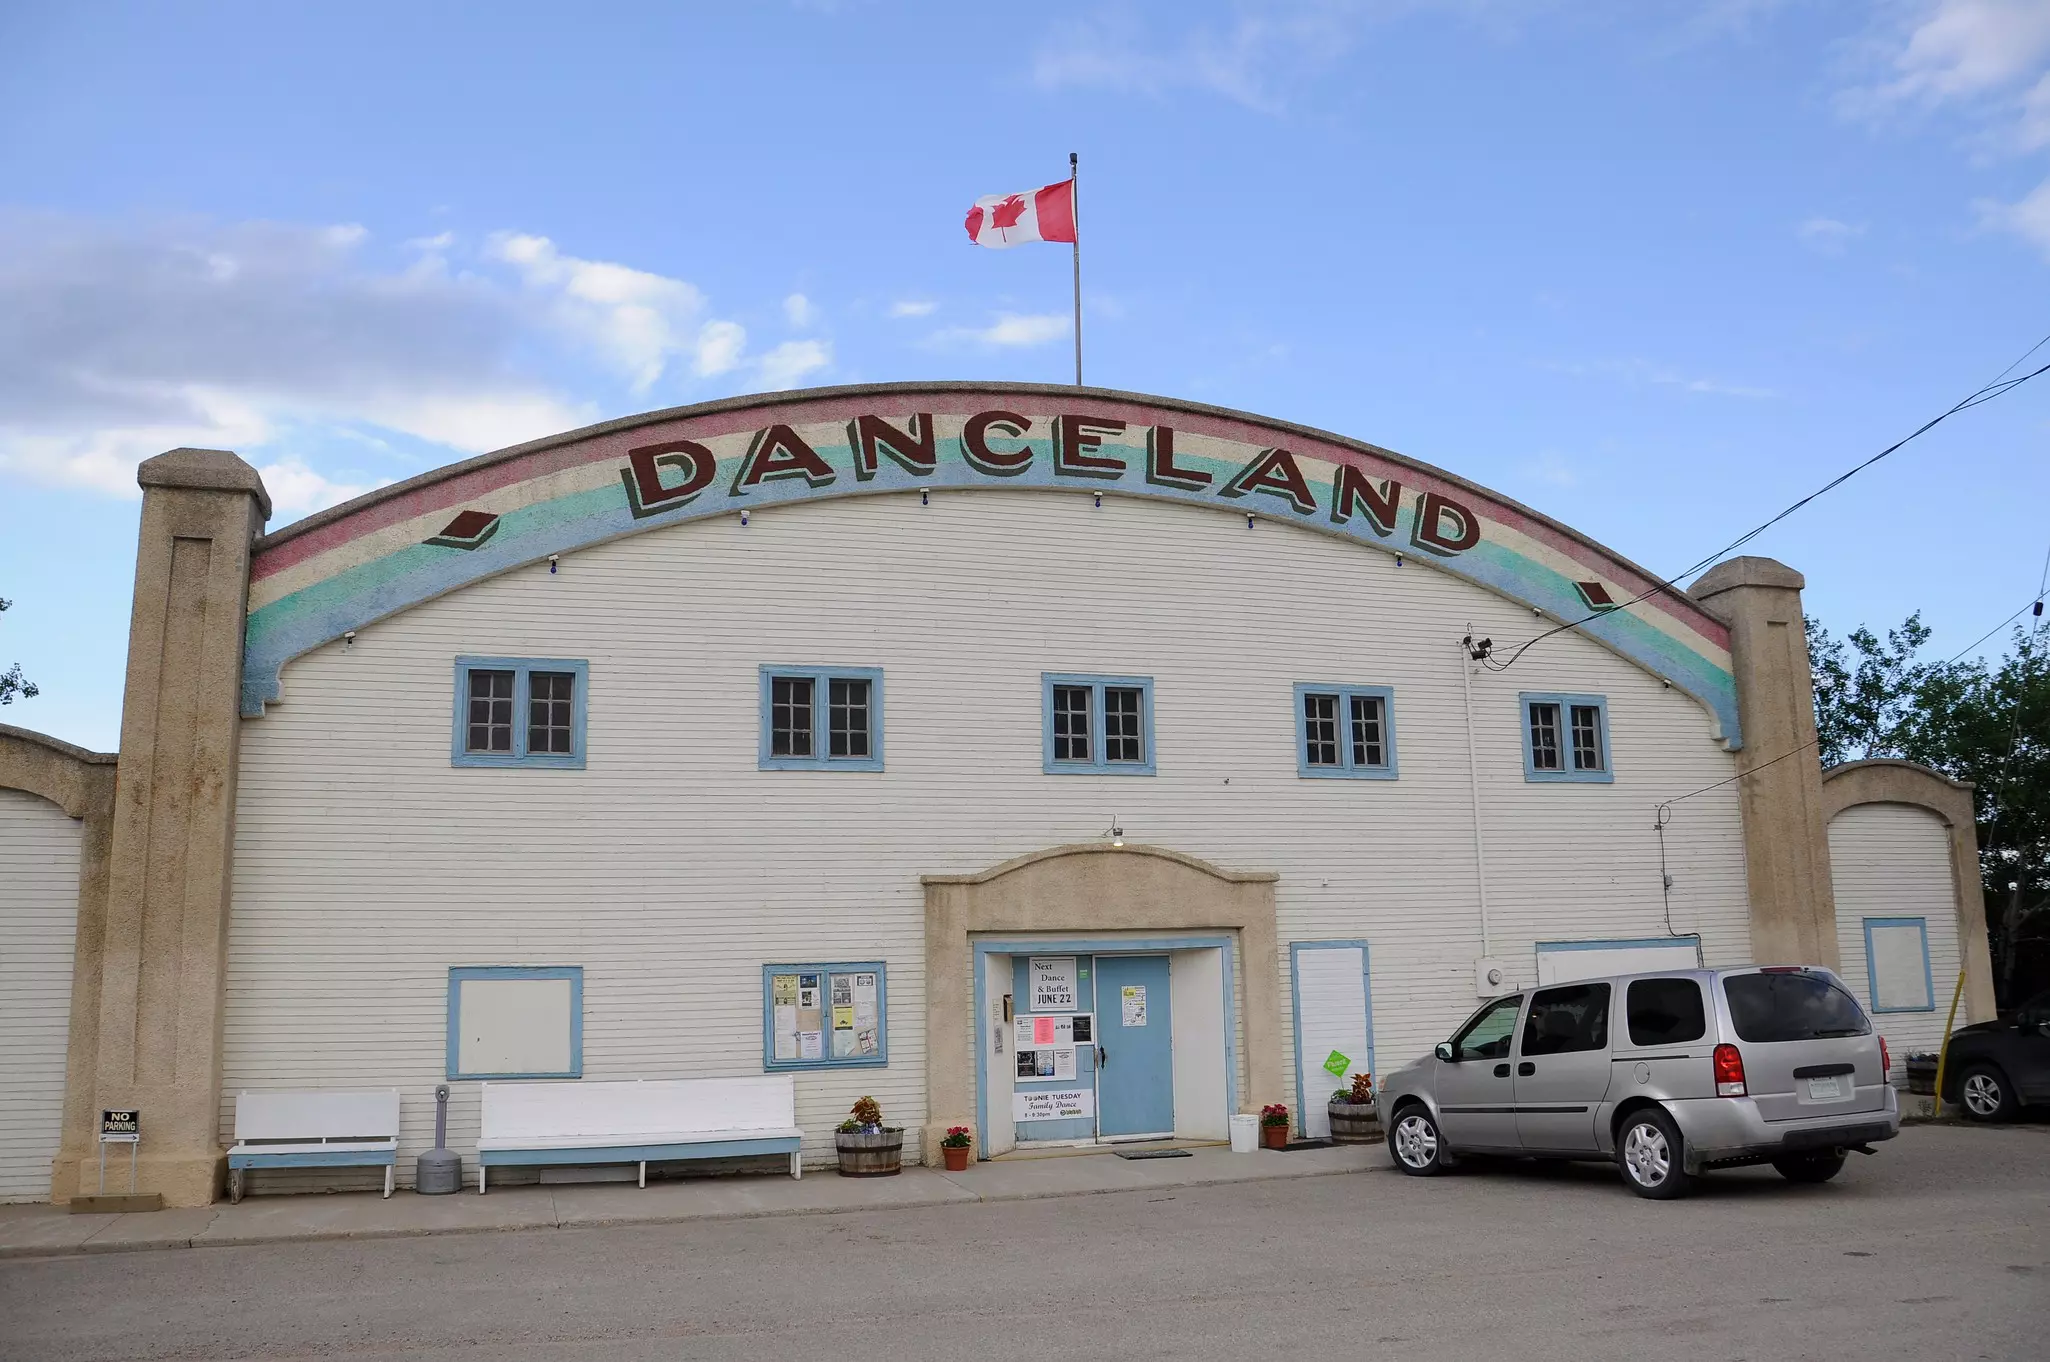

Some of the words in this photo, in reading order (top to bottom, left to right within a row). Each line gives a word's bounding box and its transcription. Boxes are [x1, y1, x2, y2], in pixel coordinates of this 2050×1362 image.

[620, 410, 1480, 557] DANCELAND
[1038, 994, 1057, 1004] JUNE
[1059, 993, 1071, 1003] 22
[1028, 1102, 1053, 1111] Family
[111, 1113, 130, 1121] NO
[104, 1121, 136, 1131] PARKING
